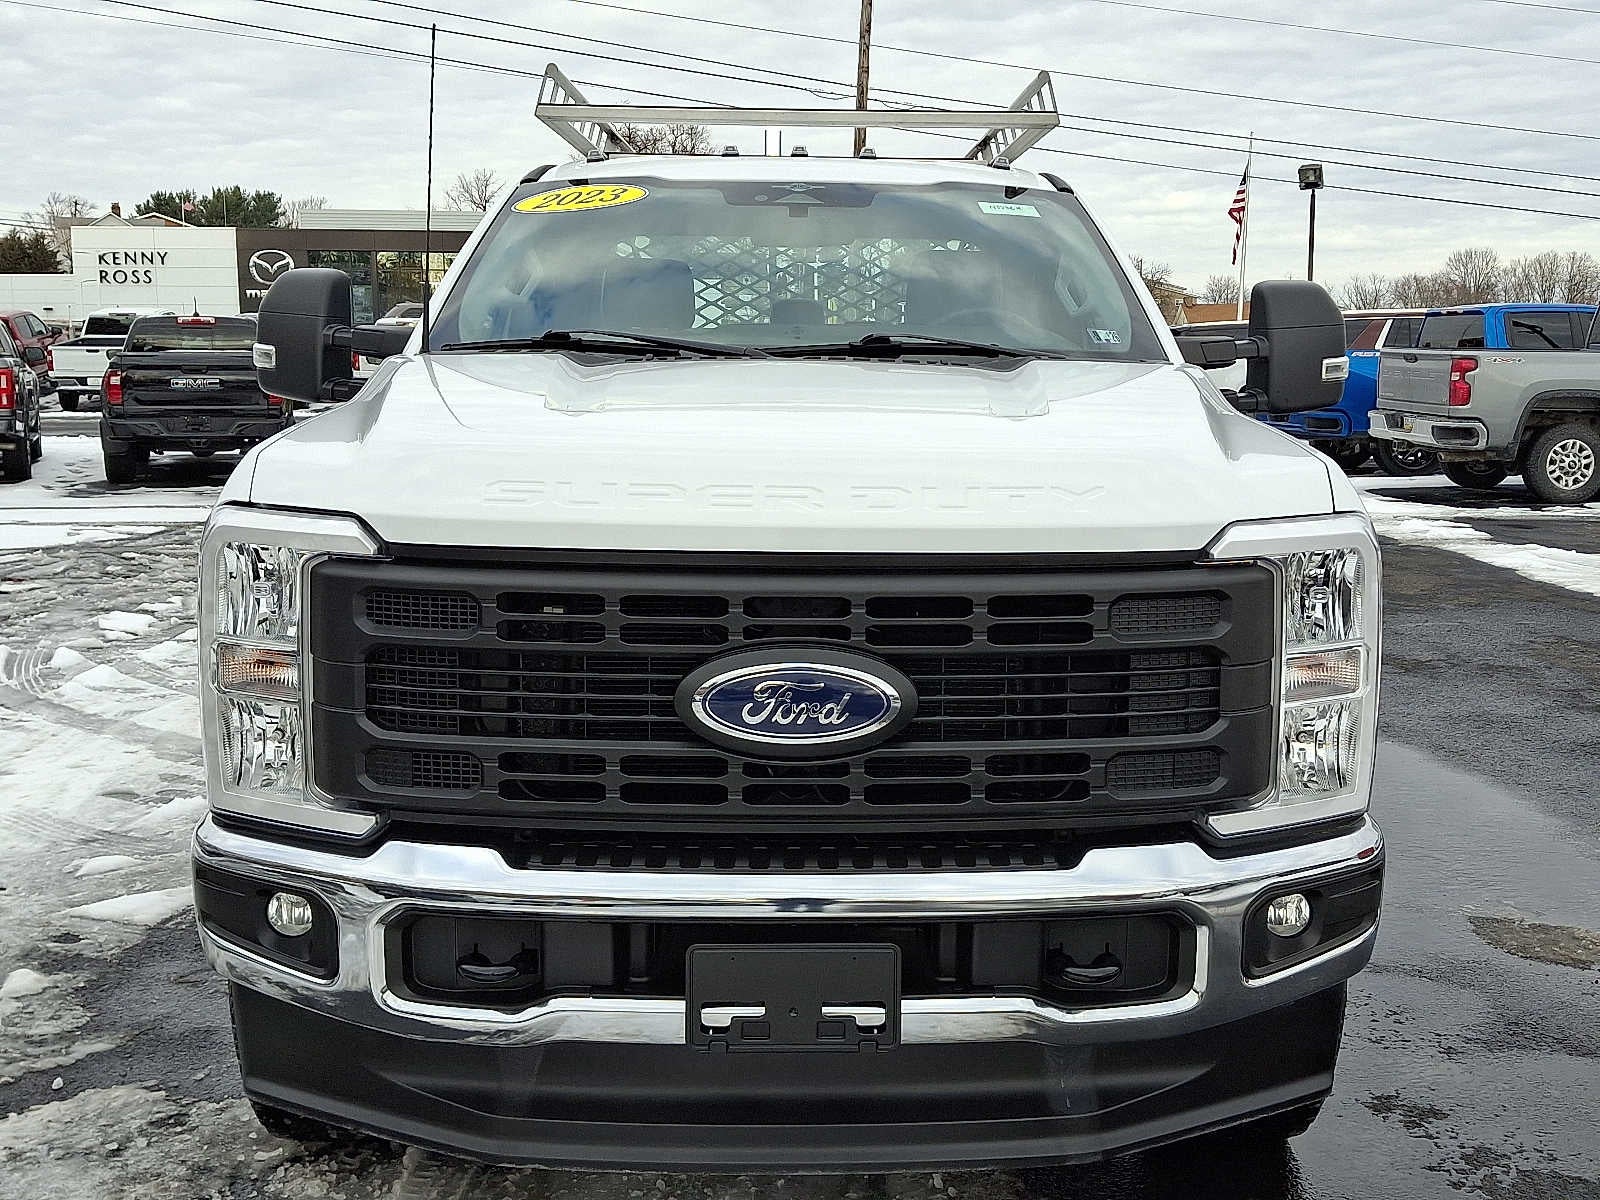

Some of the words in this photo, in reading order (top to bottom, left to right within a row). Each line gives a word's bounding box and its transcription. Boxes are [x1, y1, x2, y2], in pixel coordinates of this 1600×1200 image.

[531, 187, 629, 210] 2023
[98, 251, 168, 265] KENNY
[99, 269, 152, 284] ROSS
[170, 378, 220, 388] GMC
[482, 478, 825, 512] SUPER
[849, 485, 1105, 513] DUTY
[741, 680, 852, 725] Ford
